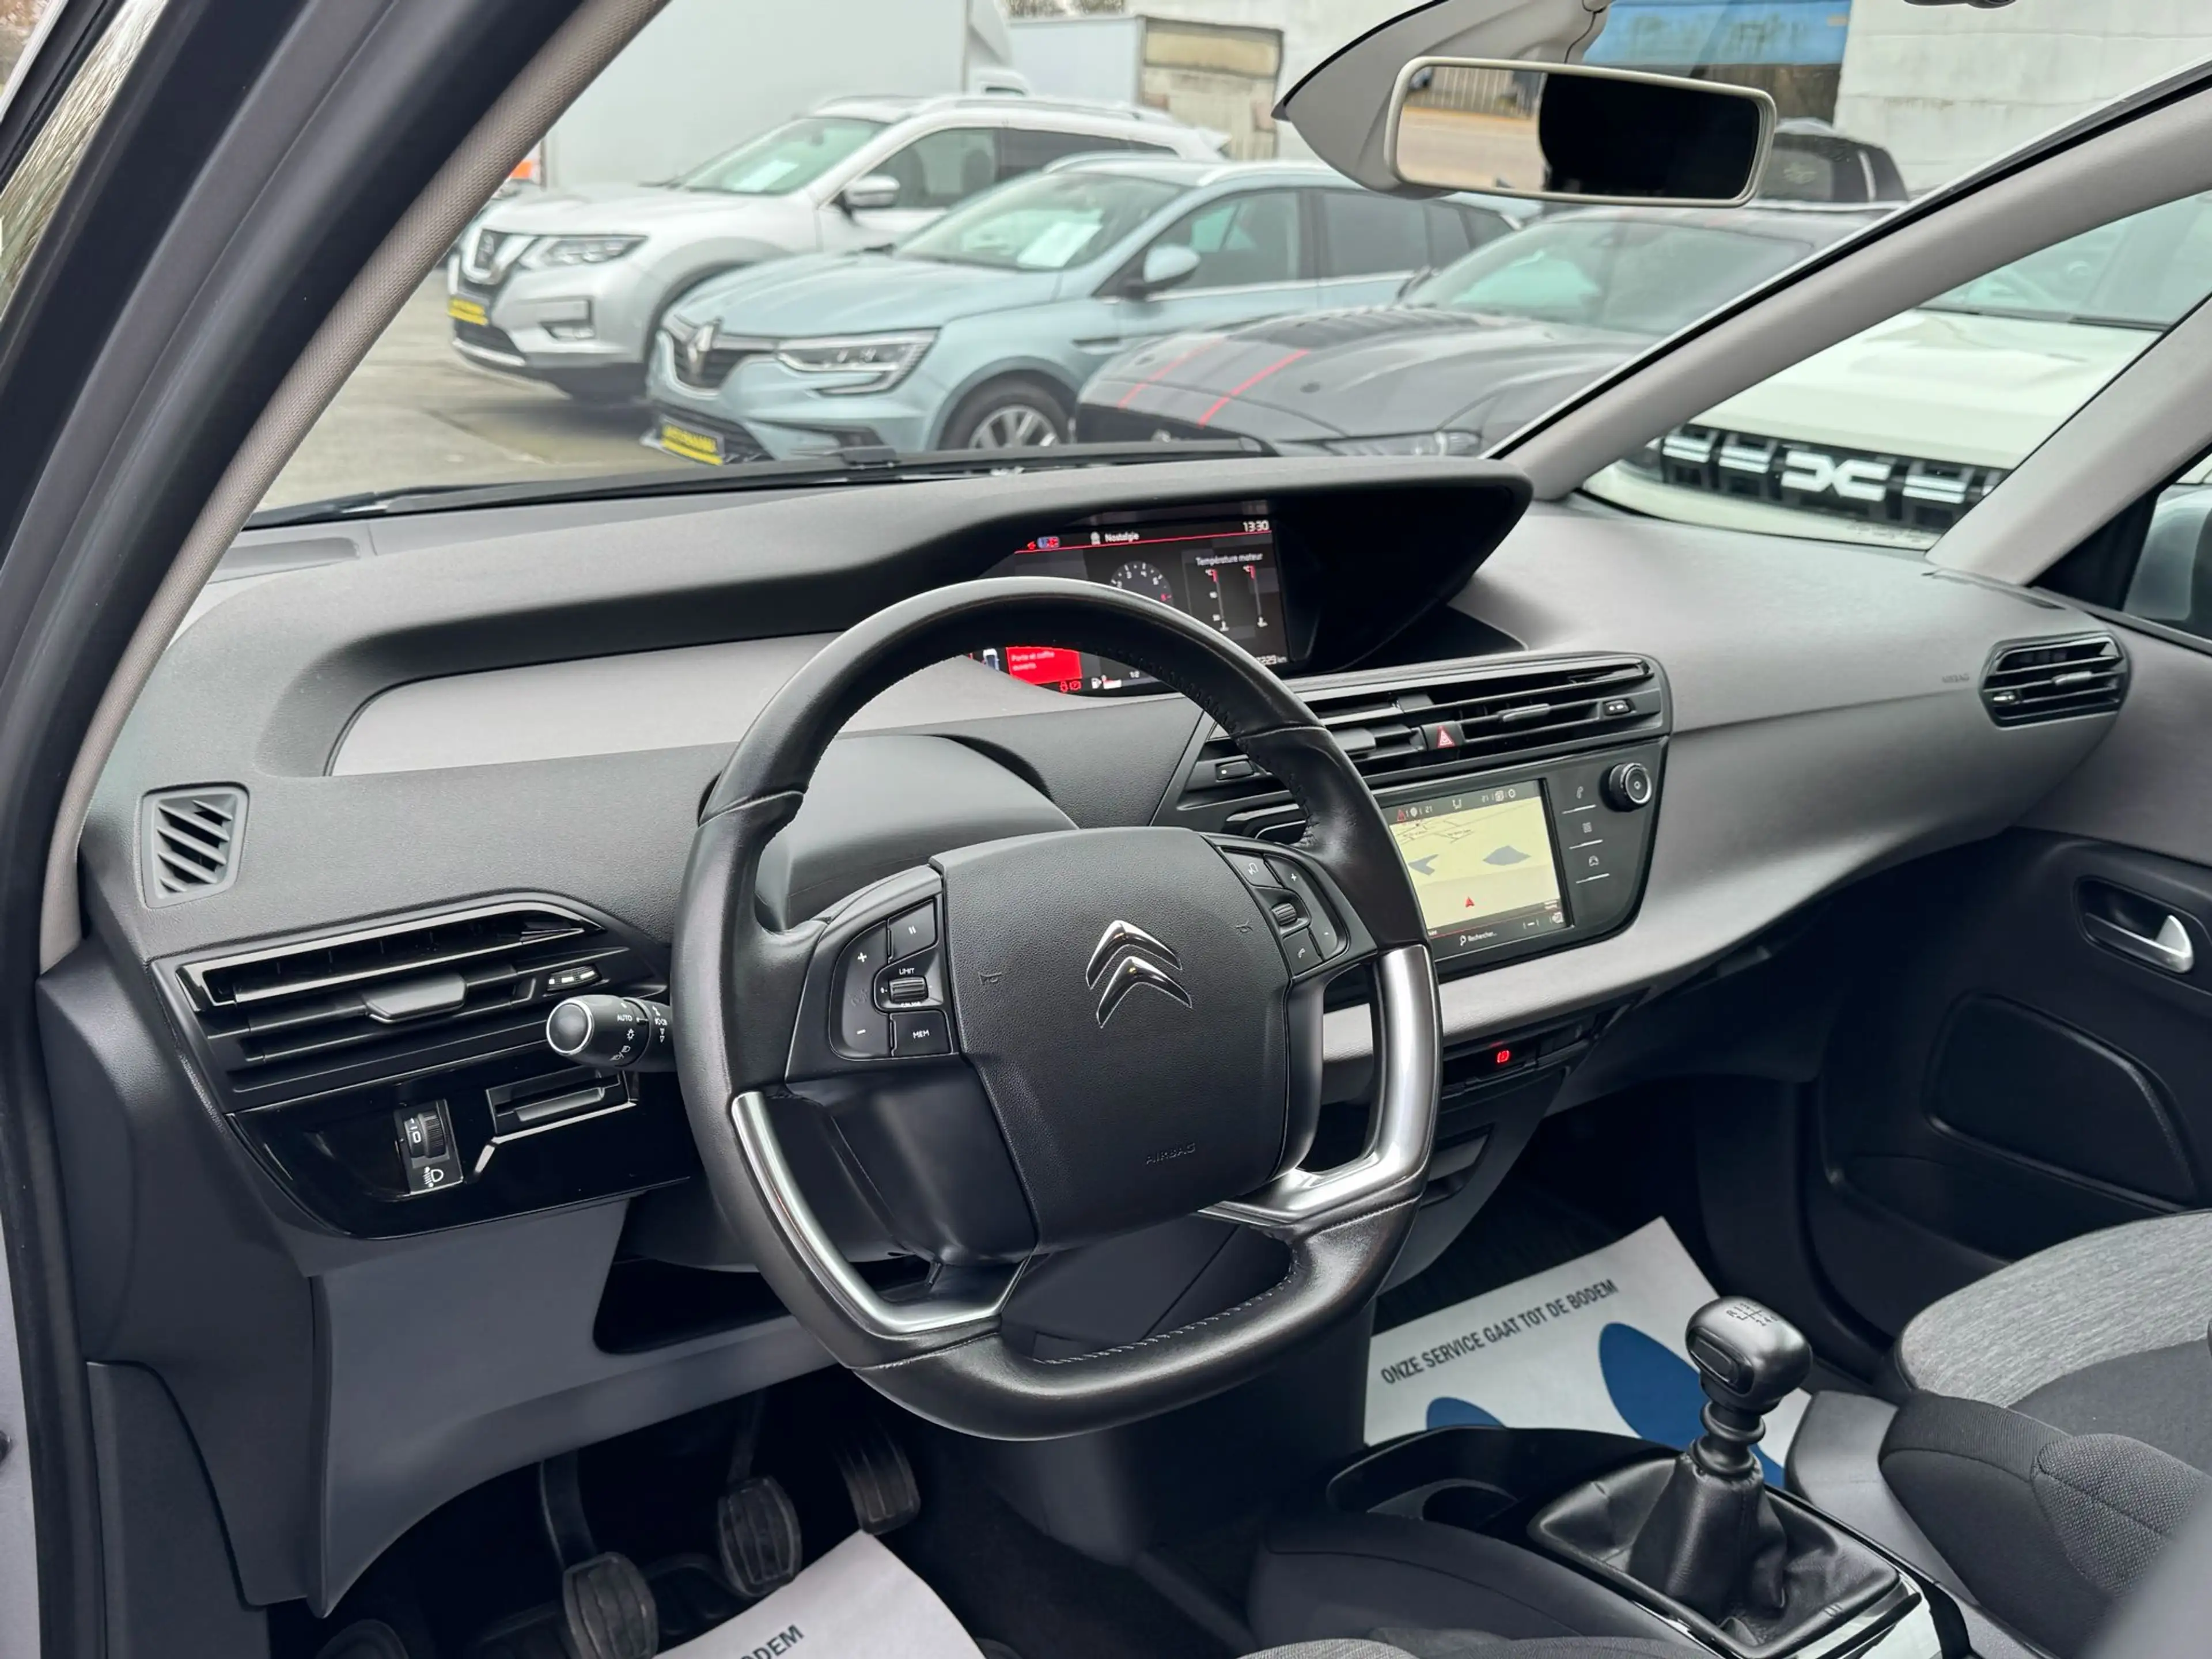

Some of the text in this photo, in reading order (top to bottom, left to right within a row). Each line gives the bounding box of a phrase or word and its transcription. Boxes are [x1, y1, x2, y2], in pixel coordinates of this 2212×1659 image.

[1104, 532, 1140, 543] Nostalgie
[1238, 552, 1263, 562] moteur
[899, 967, 915, 975] LIMIT
[617, 1014, 632, 1022] AUTO
[912, 1029, 930, 1039] MEM
[1380, 1278, 1619, 1385] ONZE SERVICE GAAT TOT DE BODEM
[741, 1624, 805, 1659] DEM
